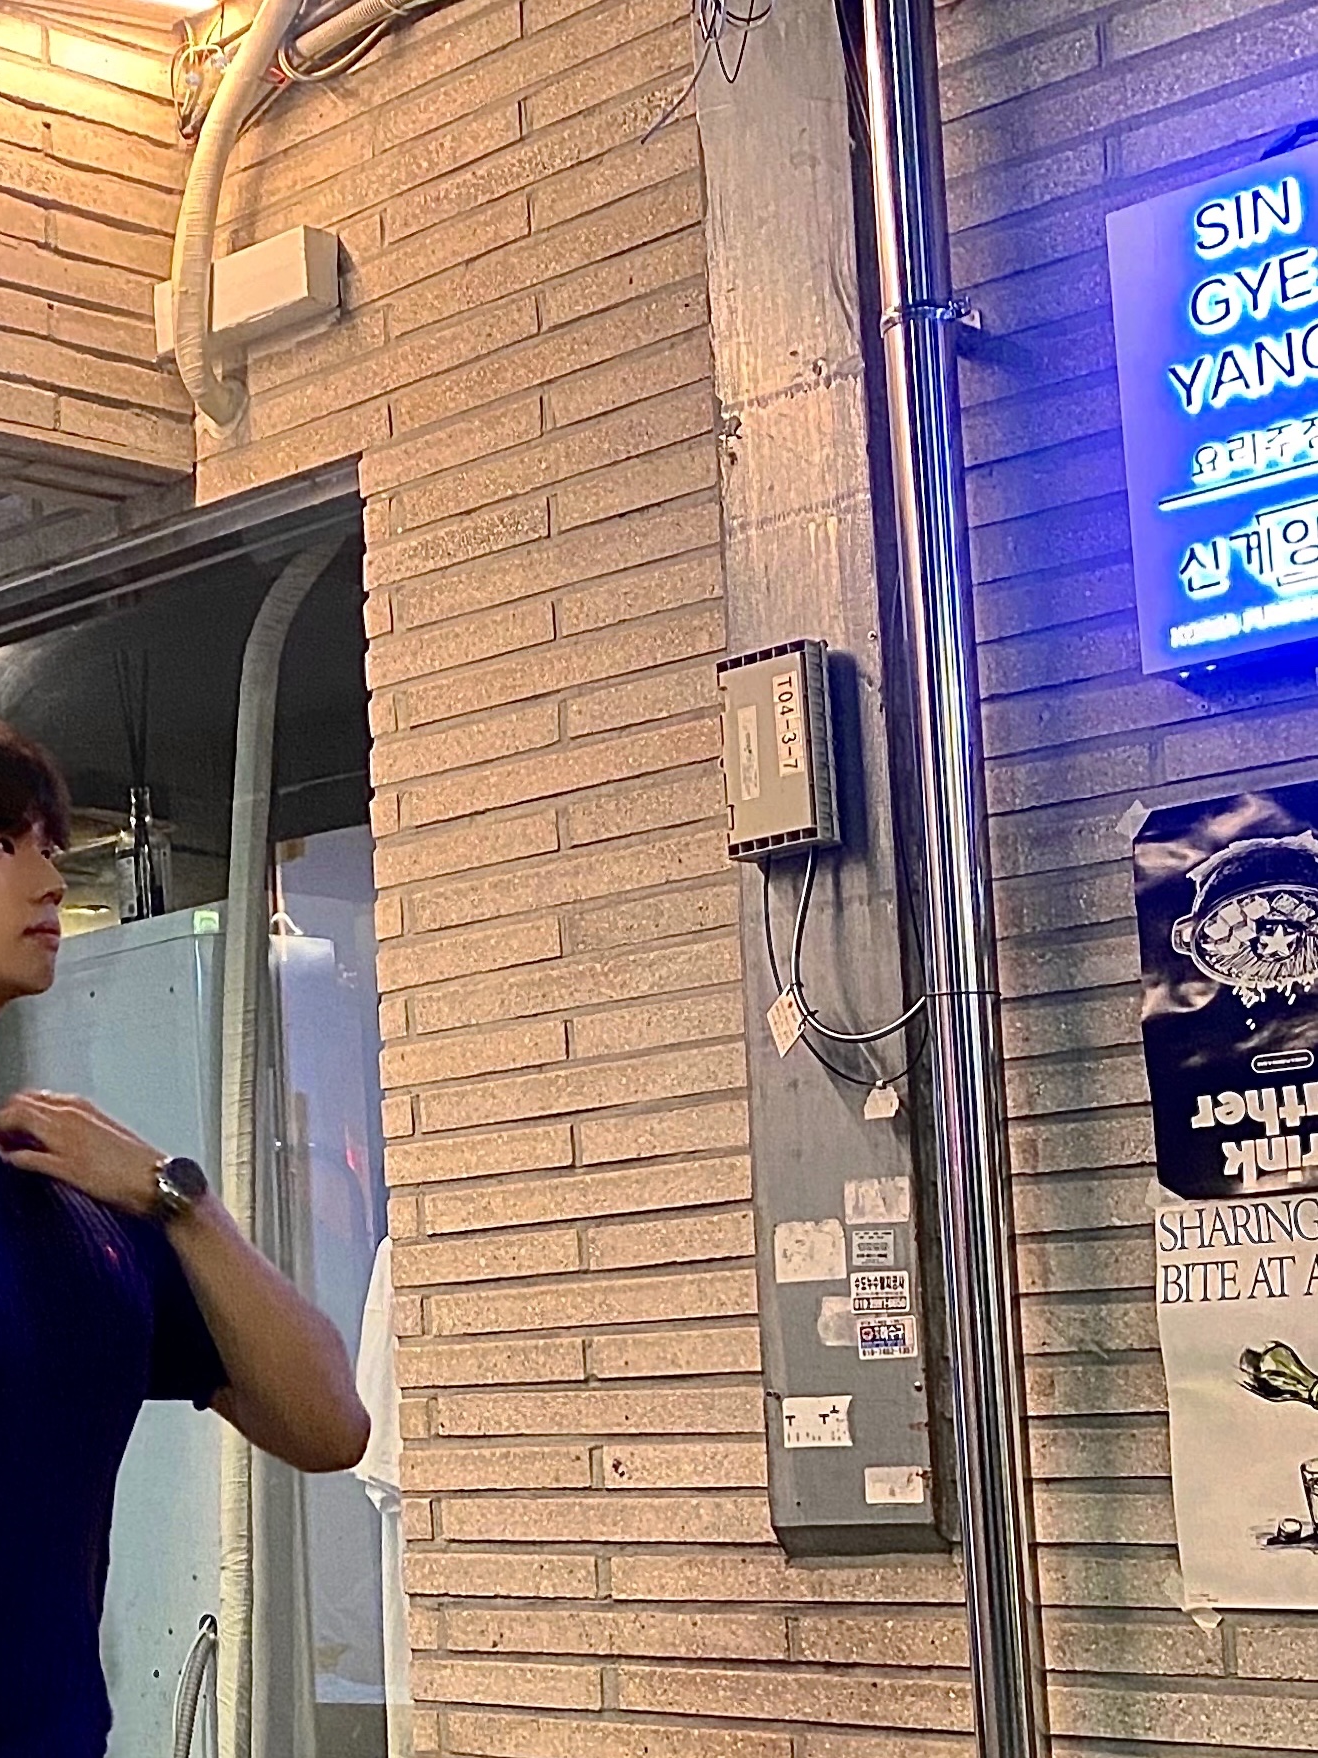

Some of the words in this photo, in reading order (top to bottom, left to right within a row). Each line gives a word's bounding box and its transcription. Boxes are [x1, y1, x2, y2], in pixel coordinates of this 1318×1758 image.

[1195, 178, 1296, 255] SIN
[1190, 248, 1317, 330] GYE
[777, 676, 799, 769] T04-3-7
[1159, 1198, 1318, 1252] SHARING
[1160, 1260, 1241, 1304] BITE
[1247, 1256, 1296, 1299] AT
